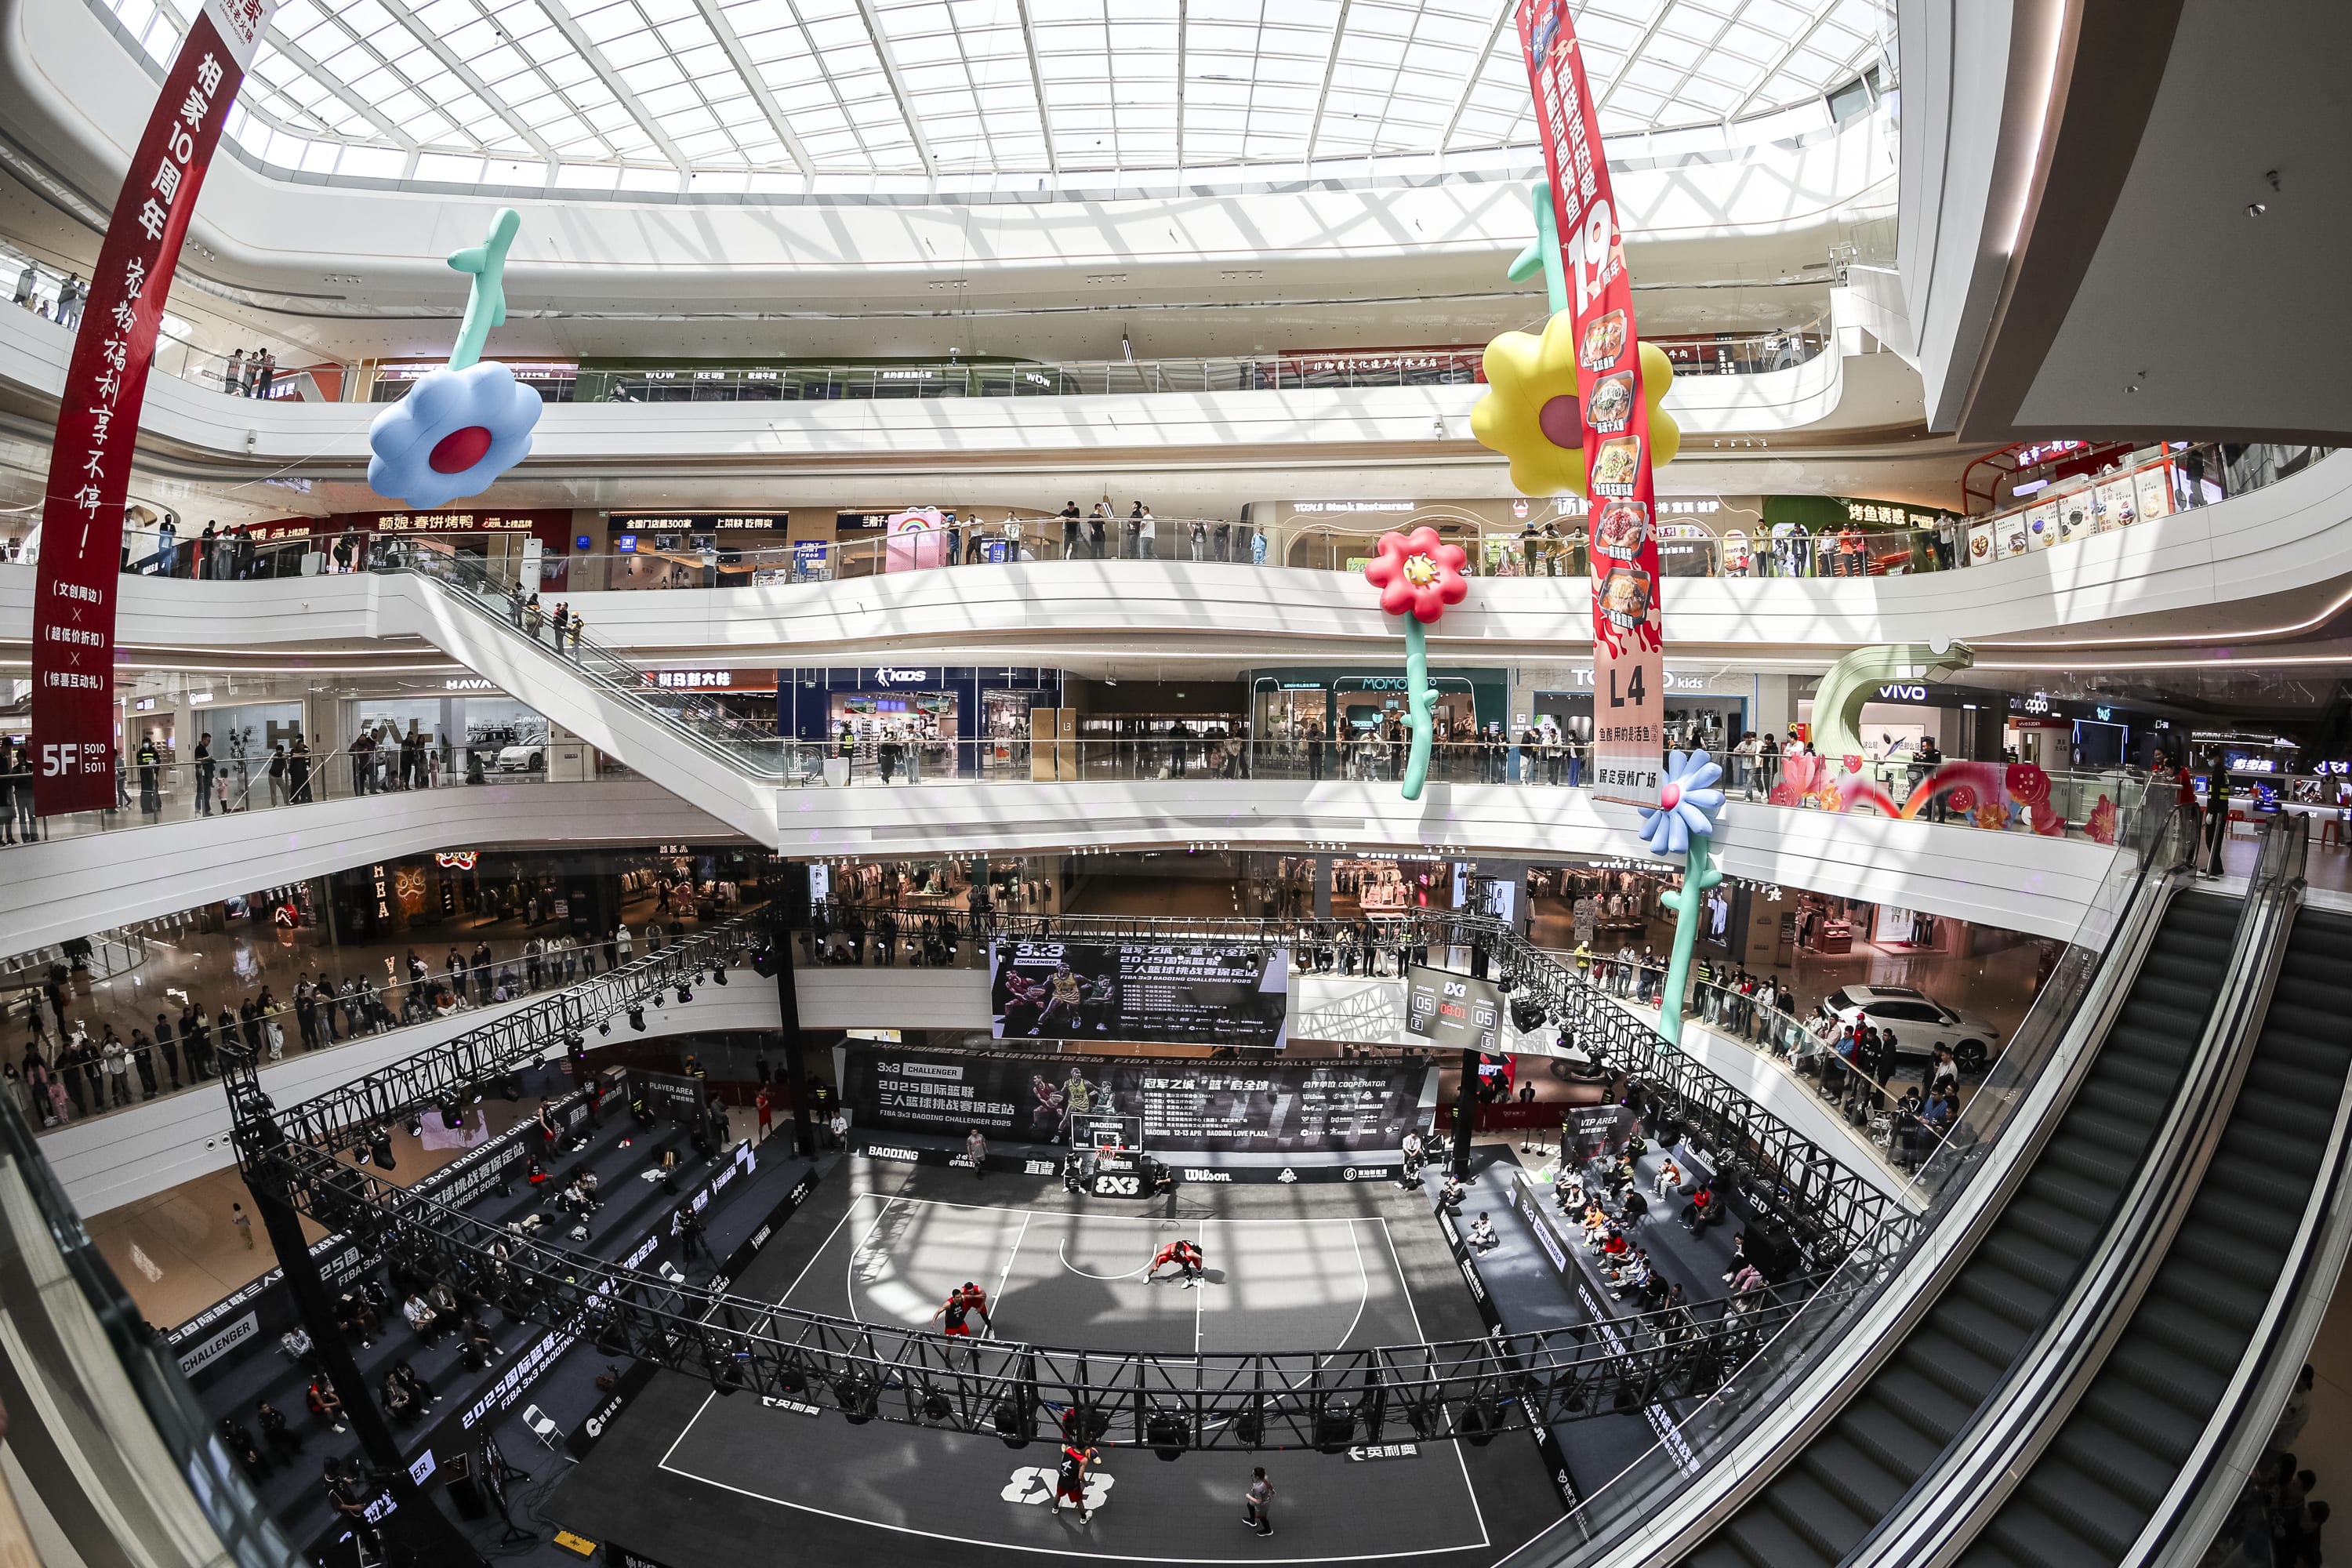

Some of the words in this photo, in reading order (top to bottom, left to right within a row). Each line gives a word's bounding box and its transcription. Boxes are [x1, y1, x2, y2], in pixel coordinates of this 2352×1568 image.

[1566, 199, 1612, 318] 19
[1602, 262, 1620, 288] 周年
[1848, 503, 1906, 524] 烤鱼诱惑
[626, 519, 692, 529] 全国门店超300家
[715, 518, 744, 528] 上菜快
[745, 518, 773, 528] 吃得爽
[45, 625, 104, 648] (超低价折扣)
[44, 673, 104, 691] (惊喜互动礼)
[658, 672, 731, 688] 斑马新大陆
[889, 670, 926, 682] KIDS
[1677, 677, 1704, 689] kids
[446, 679, 499, 690] HAVA
[1610, 665, 1646, 708] L4
[1062, 722, 1072, 731] L3
[1613, 726, 1650, 742] 用的是活鱼
[84, 742, 106, 754] 5010
[42, 743, 77, 777] 5F
[85, 761, 106, 773] 5011
[2233, 758, 2274, 771] 步步高
[1599, 768, 1657, 789] 保定爱情广场
[1120, 965, 1260, 978] 三人篮球挑战赛保定站
[1416, 996, 1432, 1011] 05
[1440, 1004, 1466, 1018] 08:01
[1475, 1011, 1493, 1025] 05
[877, 1062, 900, 1073] 3x3
[907, 1066, 957, 1077] CHALLENGER
[1187, 1058, 1260, 1067] BAODING
[1261, 1058, 1361, 1067] CHALLENGER
[649, 1082, 674, 1093] PLAYER
[675, 1086, 694, 1096] AREA
[878, 1080, 975, 1098] 2025国际篮联
[1144, 1078, 1195, 1090] 冠军之城
[879, 1093, 1015, 1116] 三人篮球挑战赛保定站
[880, 1109, 896, 1118] FIBA
[912, 1112, 944, 1122] BAODING
[945, 1114, 990, 1126] CHALLENGER
[991, 1119, 1011, 1127] 2025
[1581, 1118, 1595, 1127] VIP
[1596, 1116, 1618, 1124] AREA
[451, 1134, 507, 1170] BAODING
[868, 1145, 920, 1162] BAODING
[481, 1173, 501, 1192] 2025
[1185, 1169, 1232, 1182] Wilson
[1535, 1223, 1563, 1265] CHALLENGER
[338, 1265, 361, 1287] FIBA
[182, 1322, 251, 1374] CHALLENGER
[501, 1385, 522, 1410] FIBA
[1644, 1406, 1682, 1469] HALLENGER
[1367, 1444, 1417, 1458] 英利奥
[1061, 1459, 1072, 1472] 4
